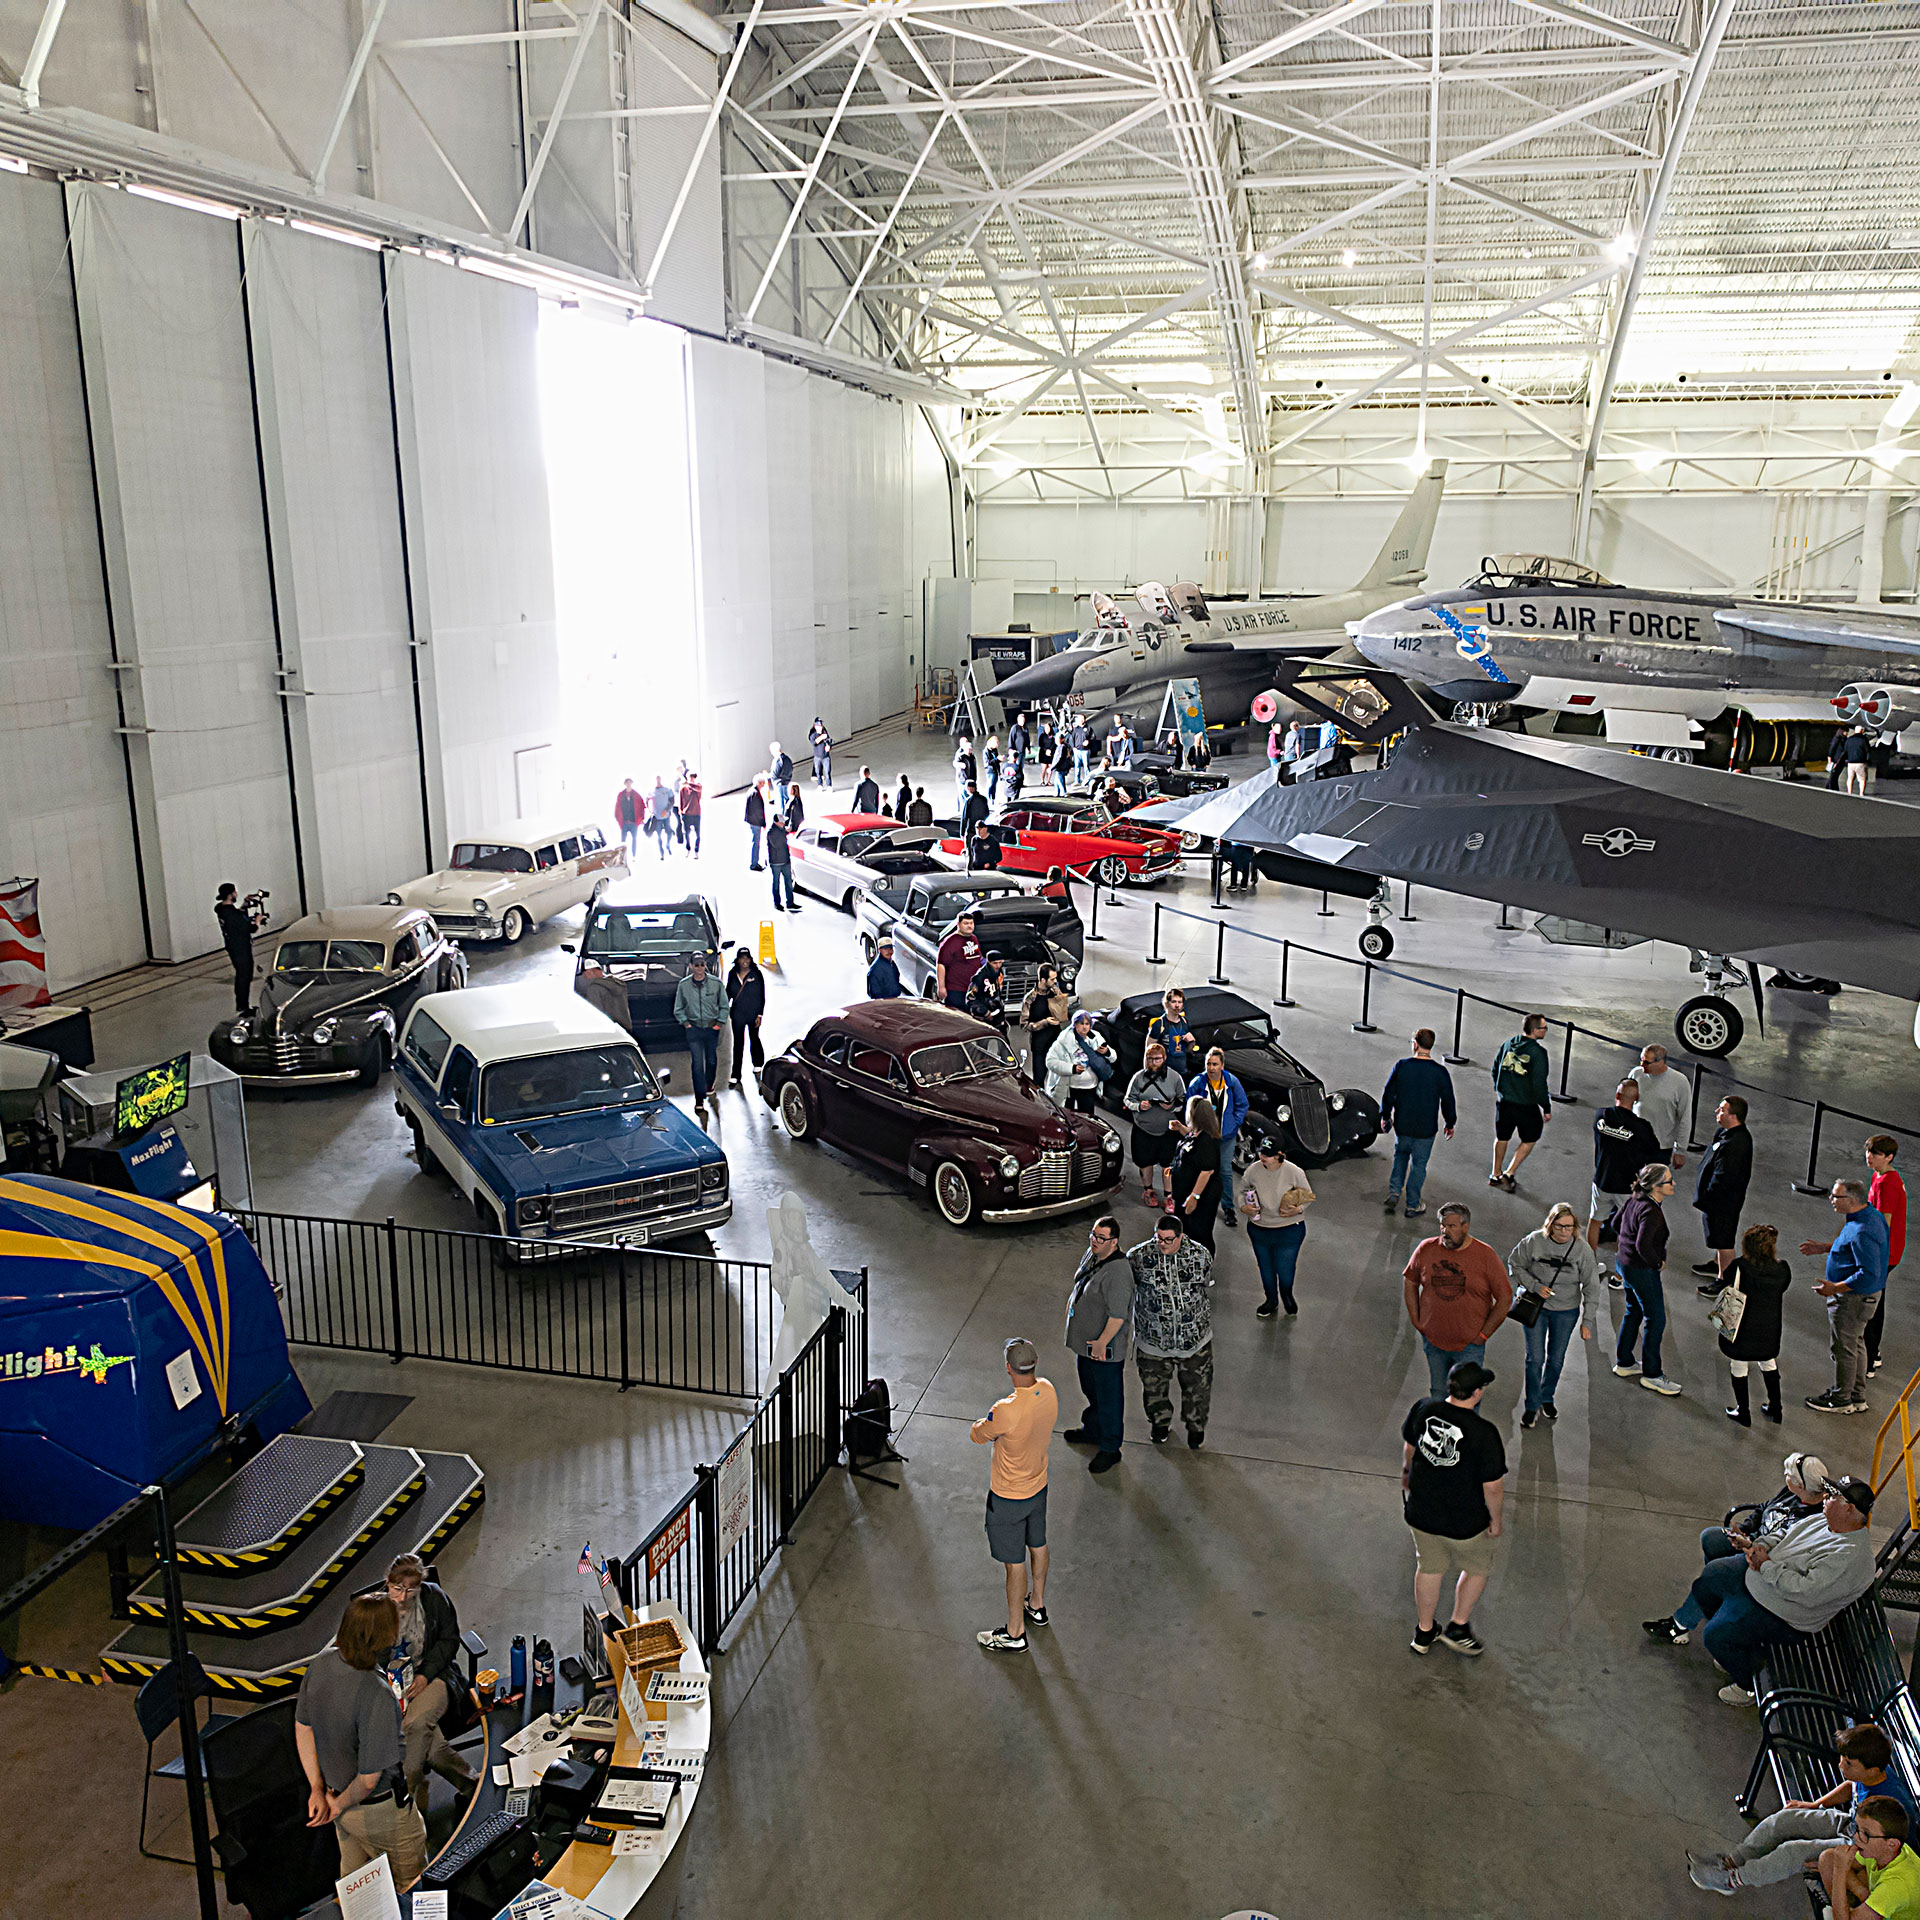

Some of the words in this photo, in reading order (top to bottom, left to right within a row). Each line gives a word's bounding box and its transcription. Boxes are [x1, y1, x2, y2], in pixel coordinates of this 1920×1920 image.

[1241, 614, 1259, 630] AIR
[1257, 609, 1291, 627] FORCE
[1552, 606, 1596, 632] AIR
[1609, 609, 1702, 642] FORCE
[1393, 637, 1422, 651] 1412
[130, 1139, 173, 1166] MaxFlight
[725, 1439, 745, 1469] SAFETY
[651, 1537, 667, 1560] DO
[667, 1511, 689, 1538] NOT
[653, 1527, 687, 1571] ENTER
[345, 1866, 382, 1895] SAFETY
[511, 1902, 531, 1912] SELECT
[531, 1896, 547, 1906] YOUR
[547, 1892, 561, 1901] RIDE
